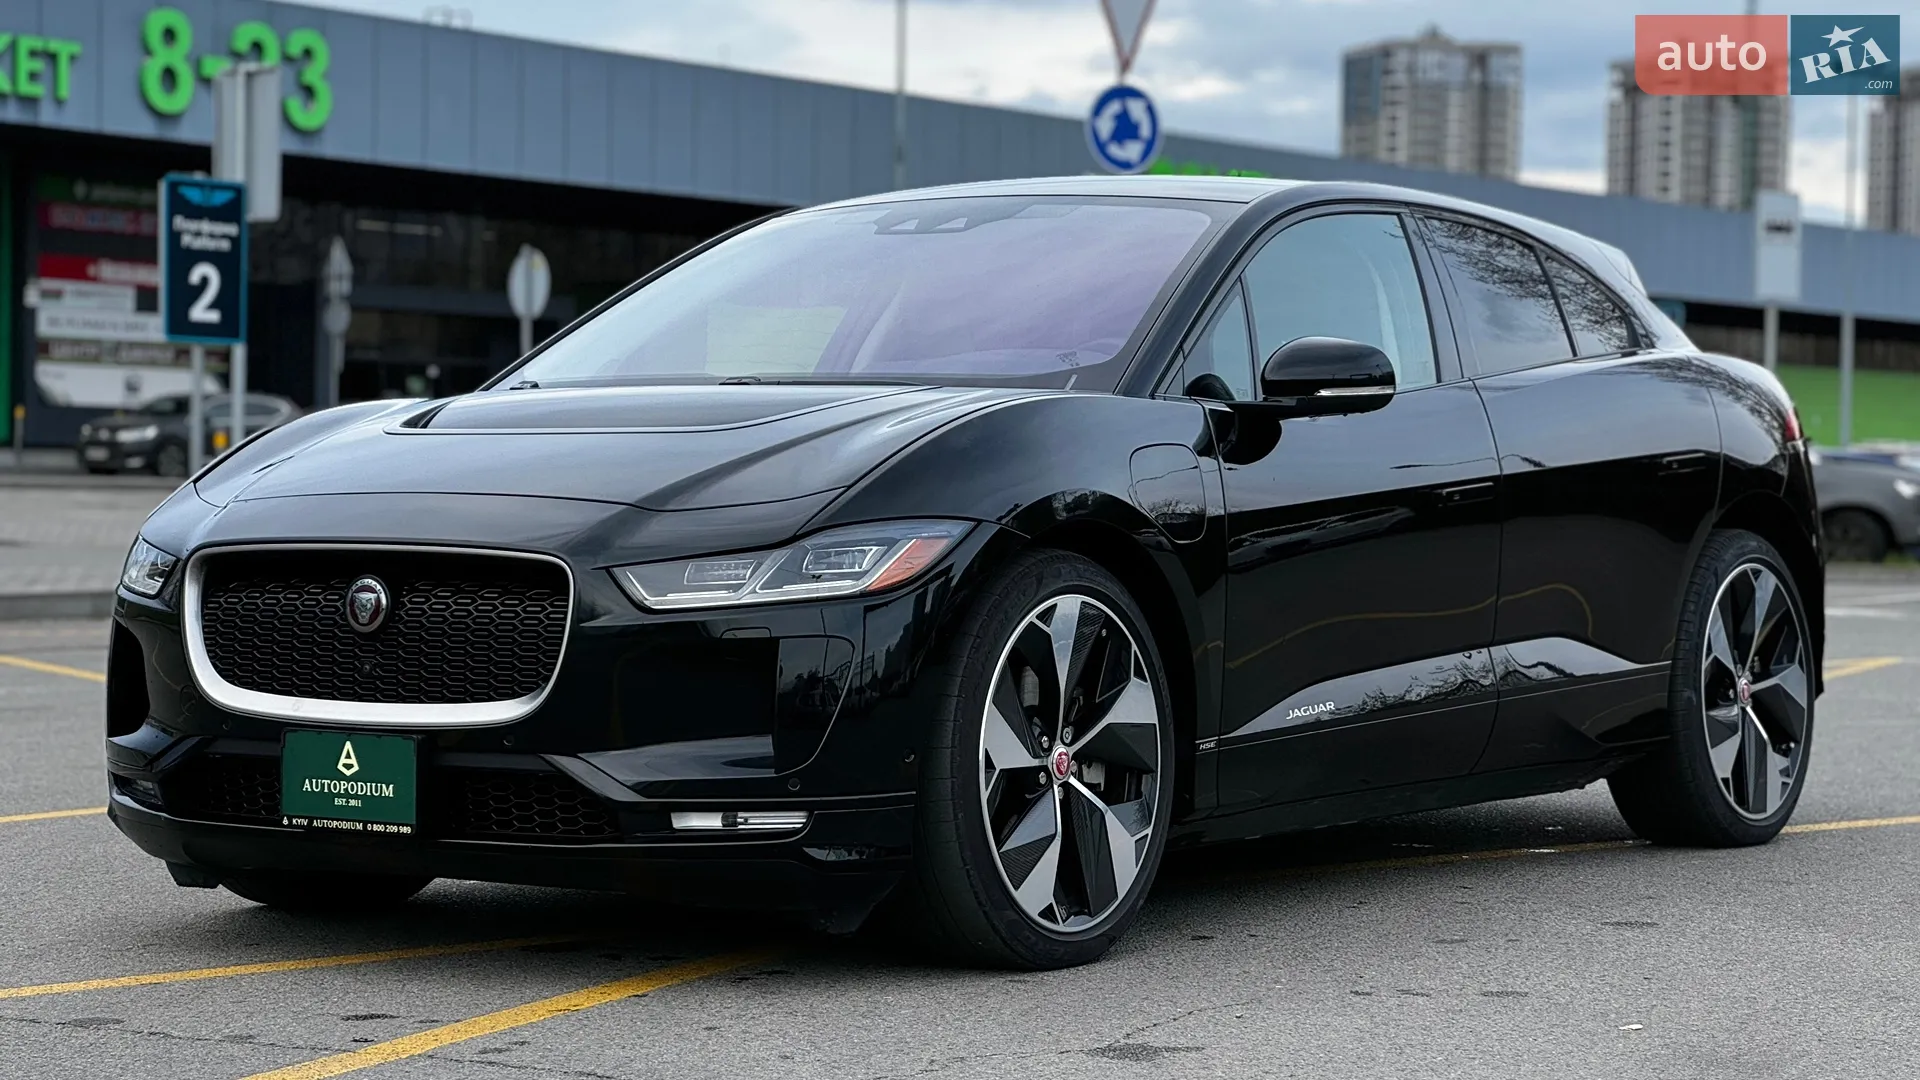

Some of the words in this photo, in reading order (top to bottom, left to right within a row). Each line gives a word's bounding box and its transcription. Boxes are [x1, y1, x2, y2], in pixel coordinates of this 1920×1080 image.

[187, 261, 222, 323] 2
[1285, 701, 1335, 720] JAGUAR
[1199, 740, 1217, 750] HSE
[302, 778, 394, 797] AUTOPODIUM
[334, 798, 348, 806] EST.
[348, 798, 362, 807] 2011
[292, 818, 308, 826] KYIV
[312, 819, 363, 831] AUTOPODIUM
[367, 823, 372, 831] 0
[373, 823, 385, 832] 800
[386, 824, 398, 833] 209
[399, 825, 411, 834] 989
